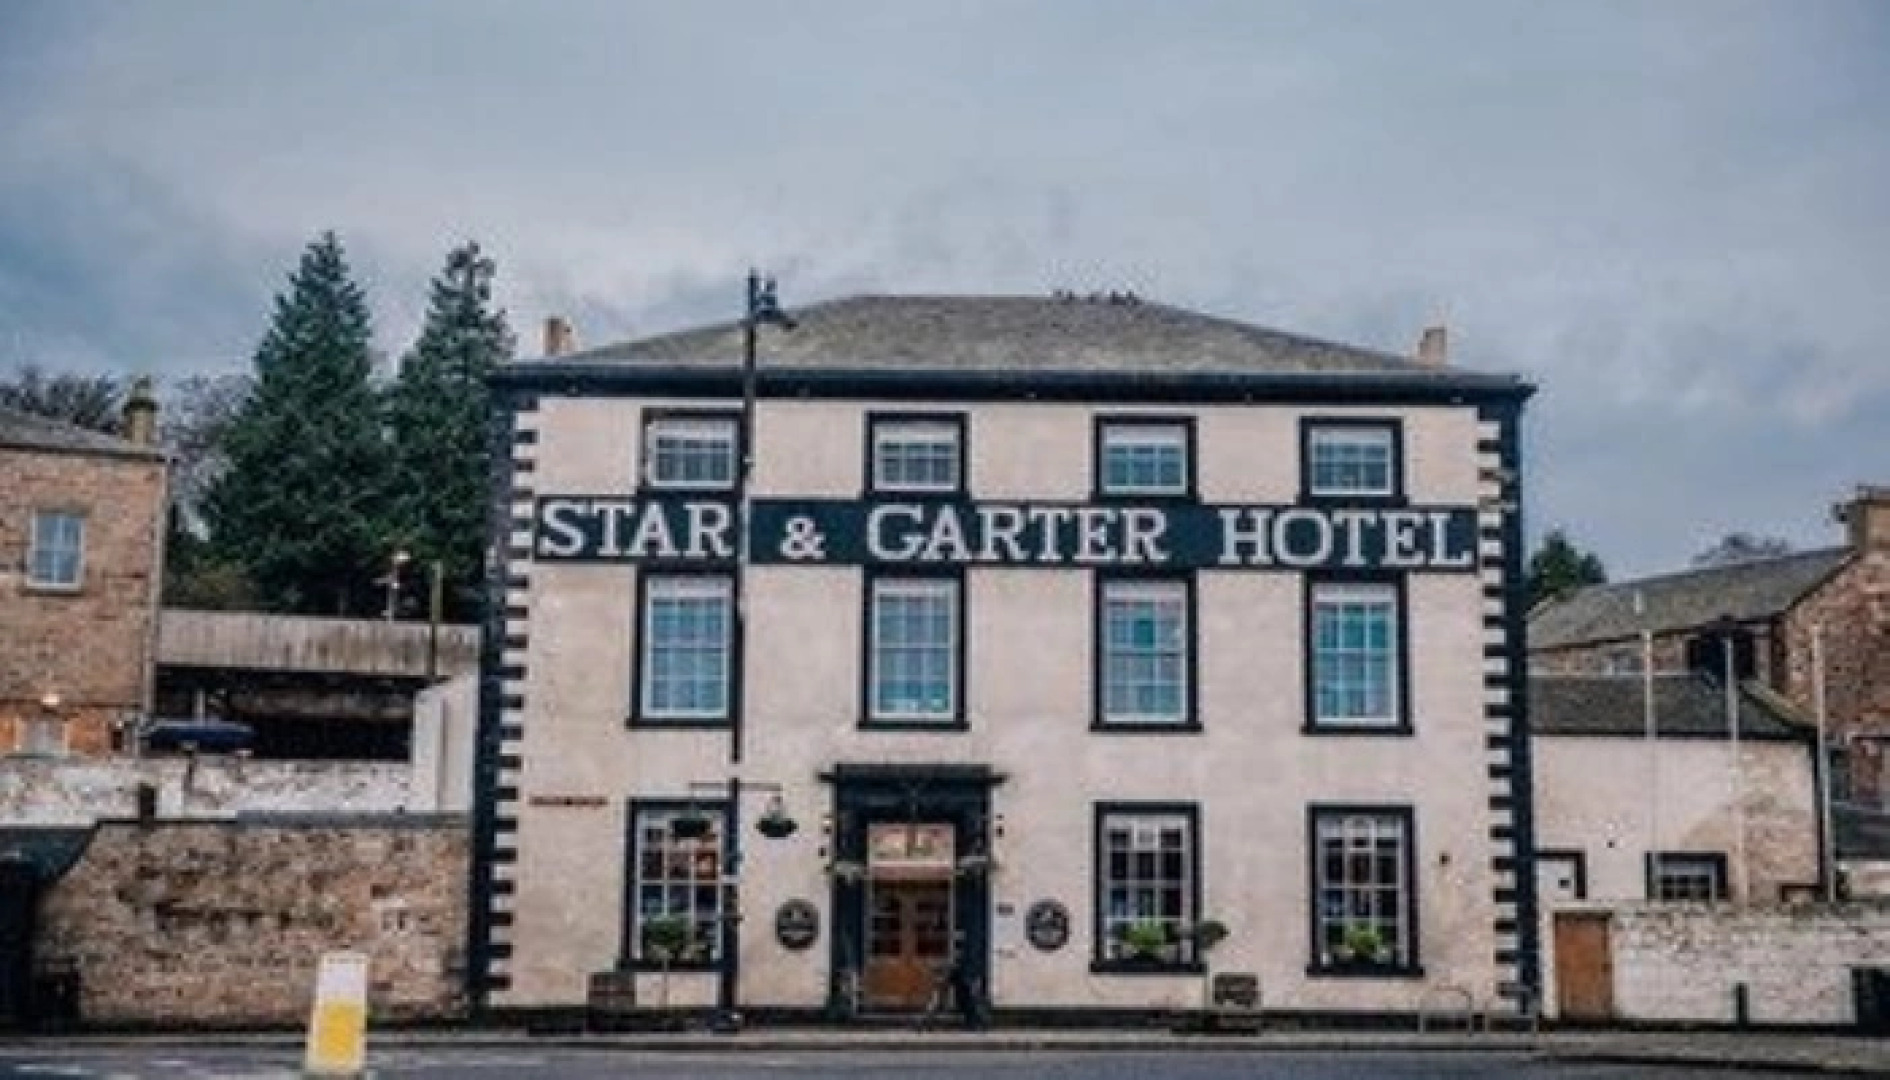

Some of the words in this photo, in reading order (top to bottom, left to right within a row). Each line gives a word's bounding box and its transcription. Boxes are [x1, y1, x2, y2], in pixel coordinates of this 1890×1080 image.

[540, 501, 734, 557] STAR
[780, 517, 825, 559] &
[866, 504, 1171, 564] GARTER
[1217, 508, 1474, 566] HOTEL
